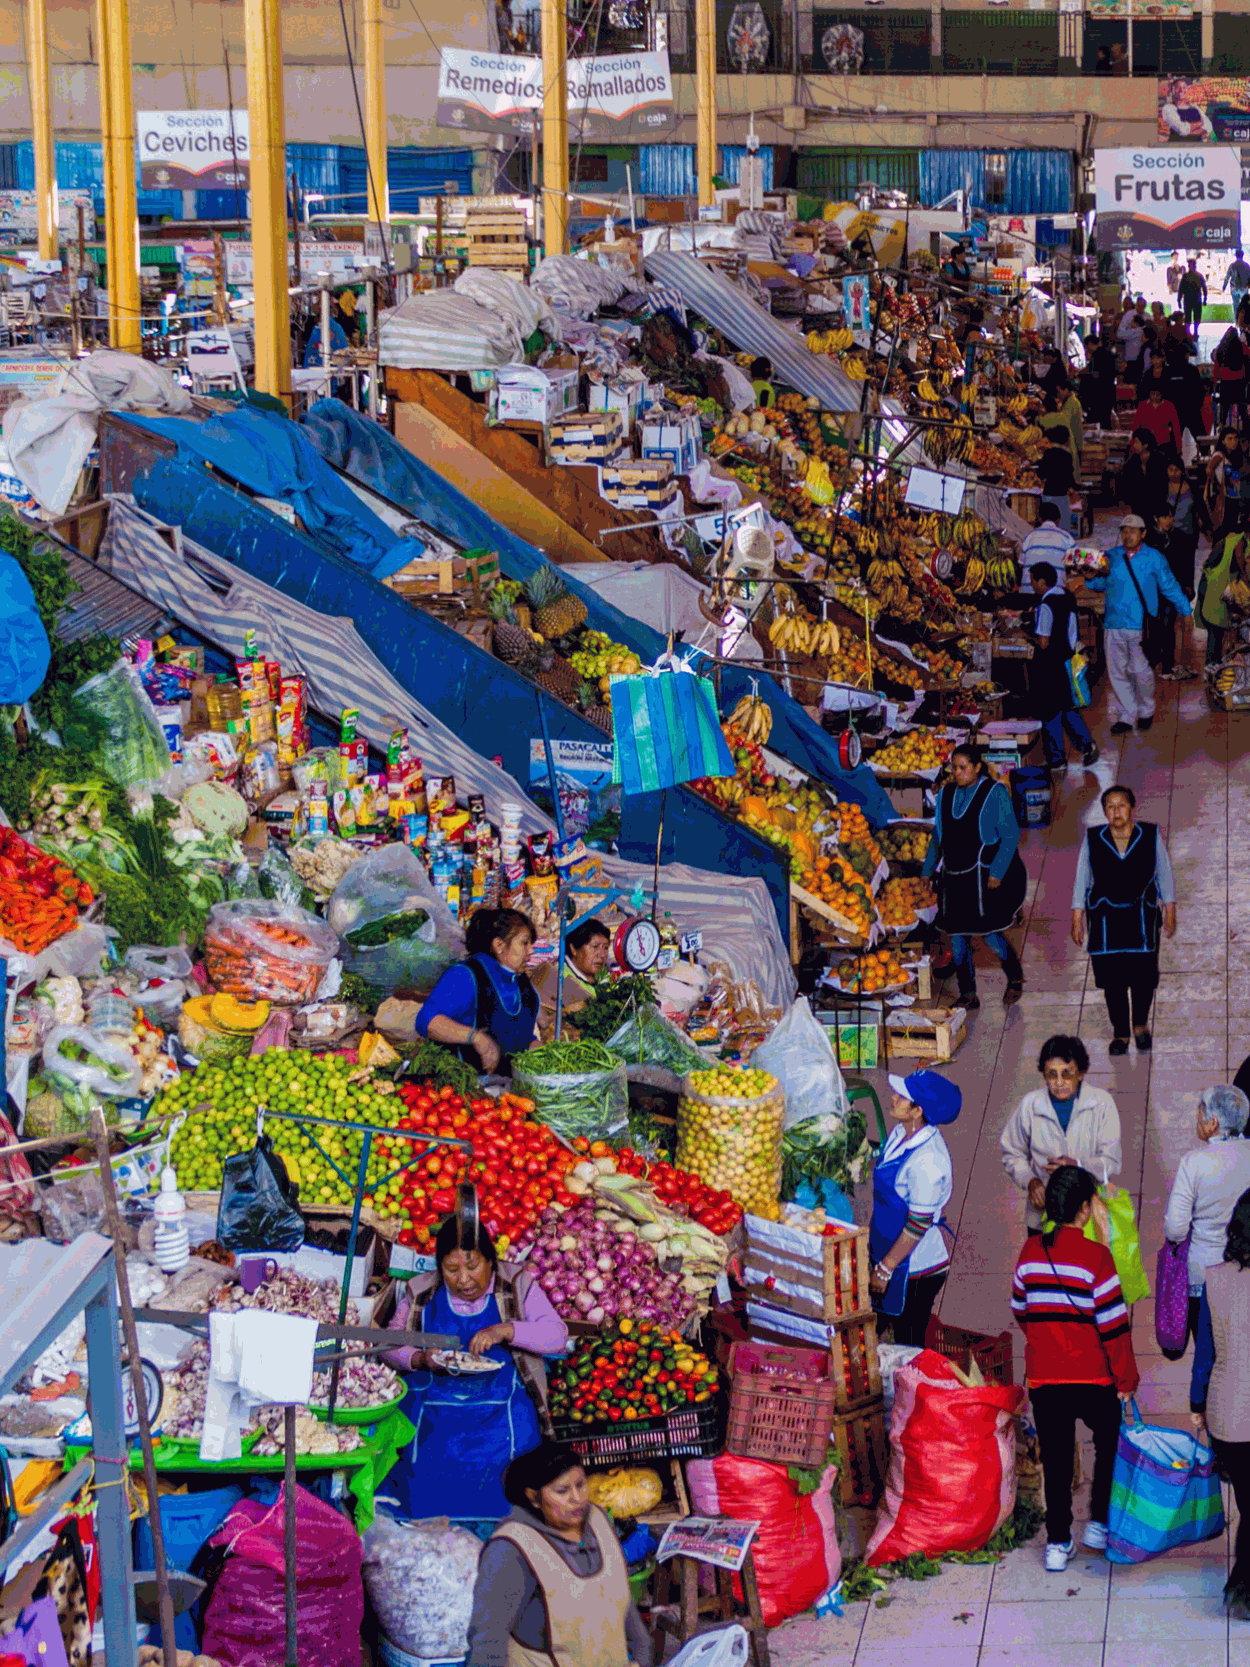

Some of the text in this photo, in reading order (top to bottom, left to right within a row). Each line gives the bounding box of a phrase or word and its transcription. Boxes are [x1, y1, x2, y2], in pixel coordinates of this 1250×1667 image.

[470, 55, 526, 73] Sección
[586, 58, 641, 74] Sección
[446, 69, 544, 100] Remedios
[566, 75, 666, 100] Remallados
[167, 115, 223, 128] Sección
[144, 131, 248, 152] Ceviches
[1132, 152, 1205, 169] Sección
[1114, 174, 1226, 202] Frutas
[1206, 226, 1231, 239] caja
